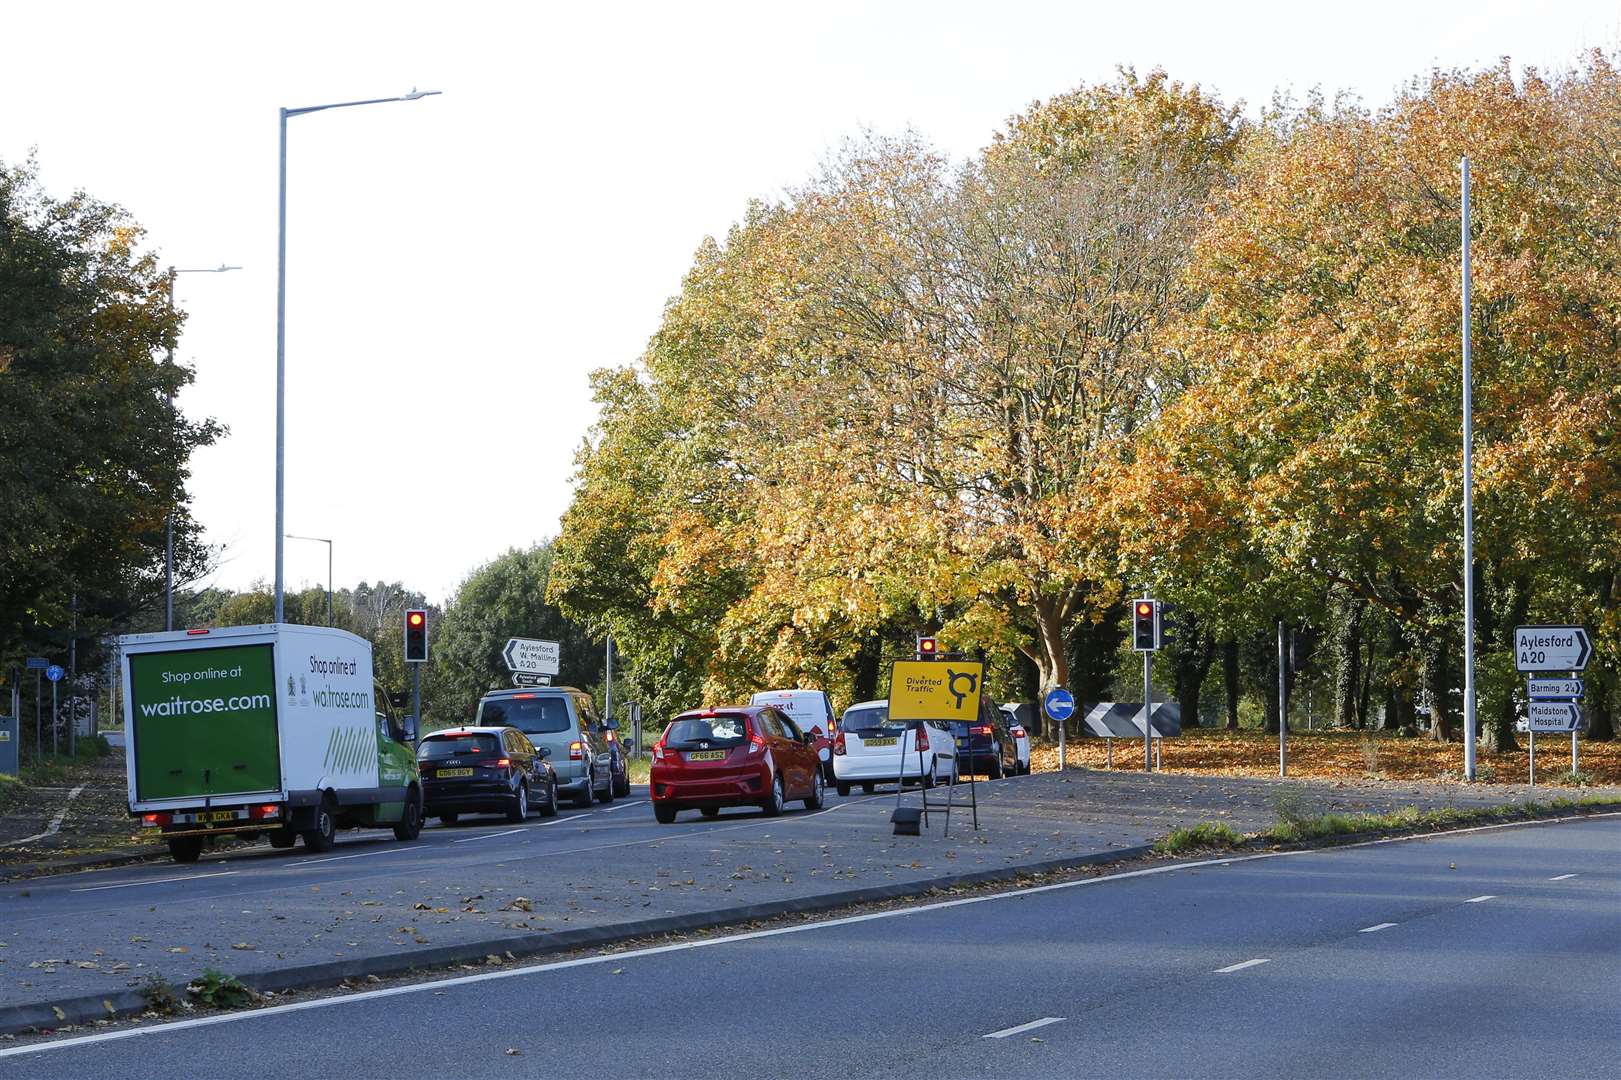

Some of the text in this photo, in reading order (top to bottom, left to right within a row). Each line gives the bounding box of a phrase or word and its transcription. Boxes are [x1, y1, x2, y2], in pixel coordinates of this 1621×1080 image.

[1520, 635, 1572, 650] Aylesford
[520, 643, 554, 653] Aylesford
[530, 653, 557, 663] Malling
[1521, 651, 1545, 664] A20
[309, 655, 357, 679] Shop online at
[520, 660, 537, 669] A20
[161, 666, 242, 684] Shop online at
[906, 677, 942, 686] Diverted
[906, 685, 933, 693] Traffic
[1531, 684, 1560, 693] Barming
[312, 684, 369, 709] waitrose.com
[140, 694, 271, 717] waitrose.com
[1531, 707, 1568, 715] Maidstone
[1534, 717, 1564, 726] Hospital
[691, 752, 709, 760] GF66
